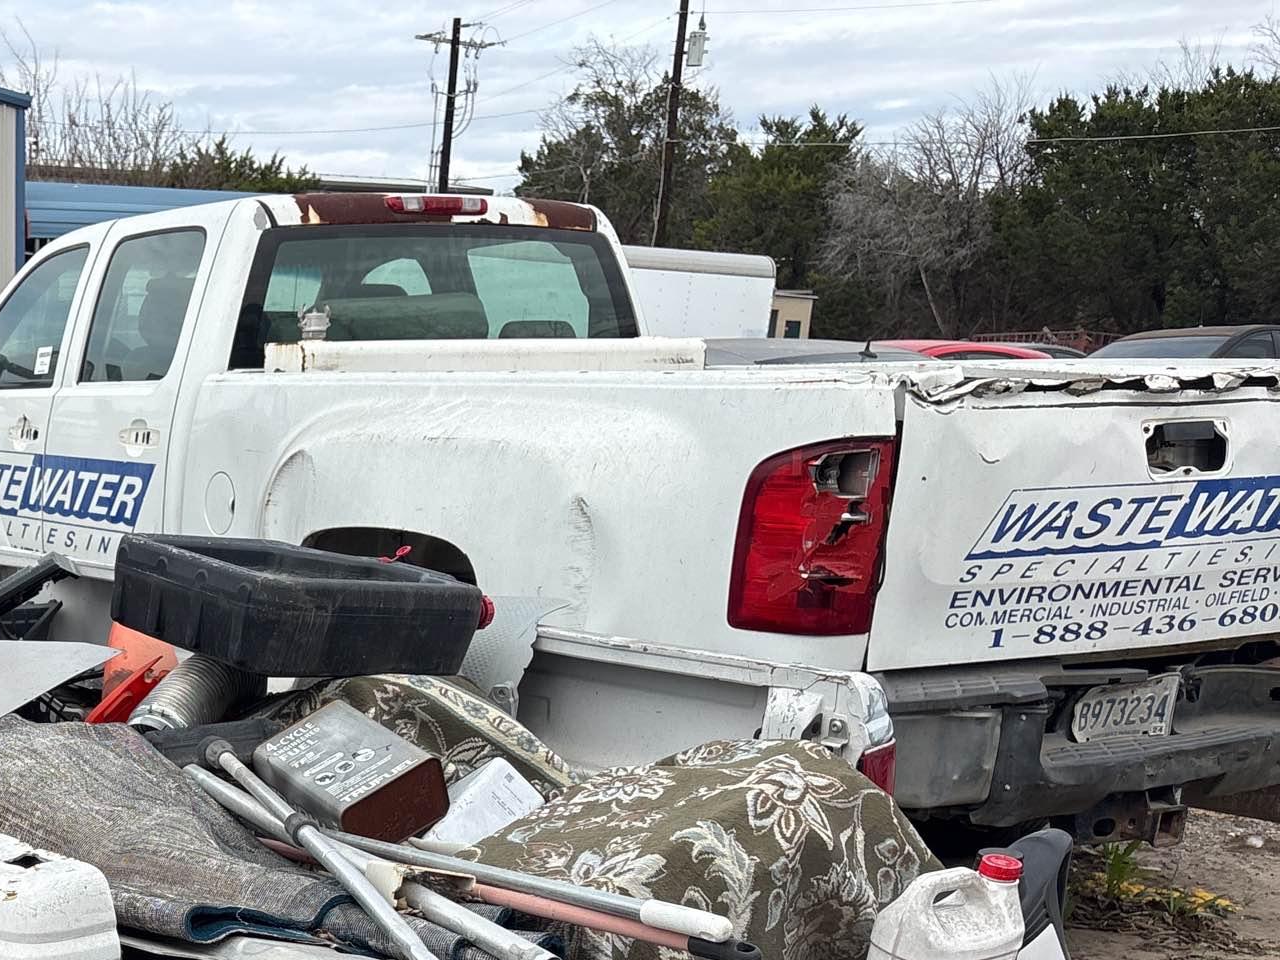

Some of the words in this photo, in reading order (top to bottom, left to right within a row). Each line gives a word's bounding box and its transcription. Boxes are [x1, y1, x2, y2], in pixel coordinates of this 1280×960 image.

[948, 573, 1206, 610] ENVIRONMENTAL
[1089, 597, 1191, 618] INDUSTRIAL
[1205, 587, 1269, 608] OILFIELD
[278, 738, 320, 762] FUEL
